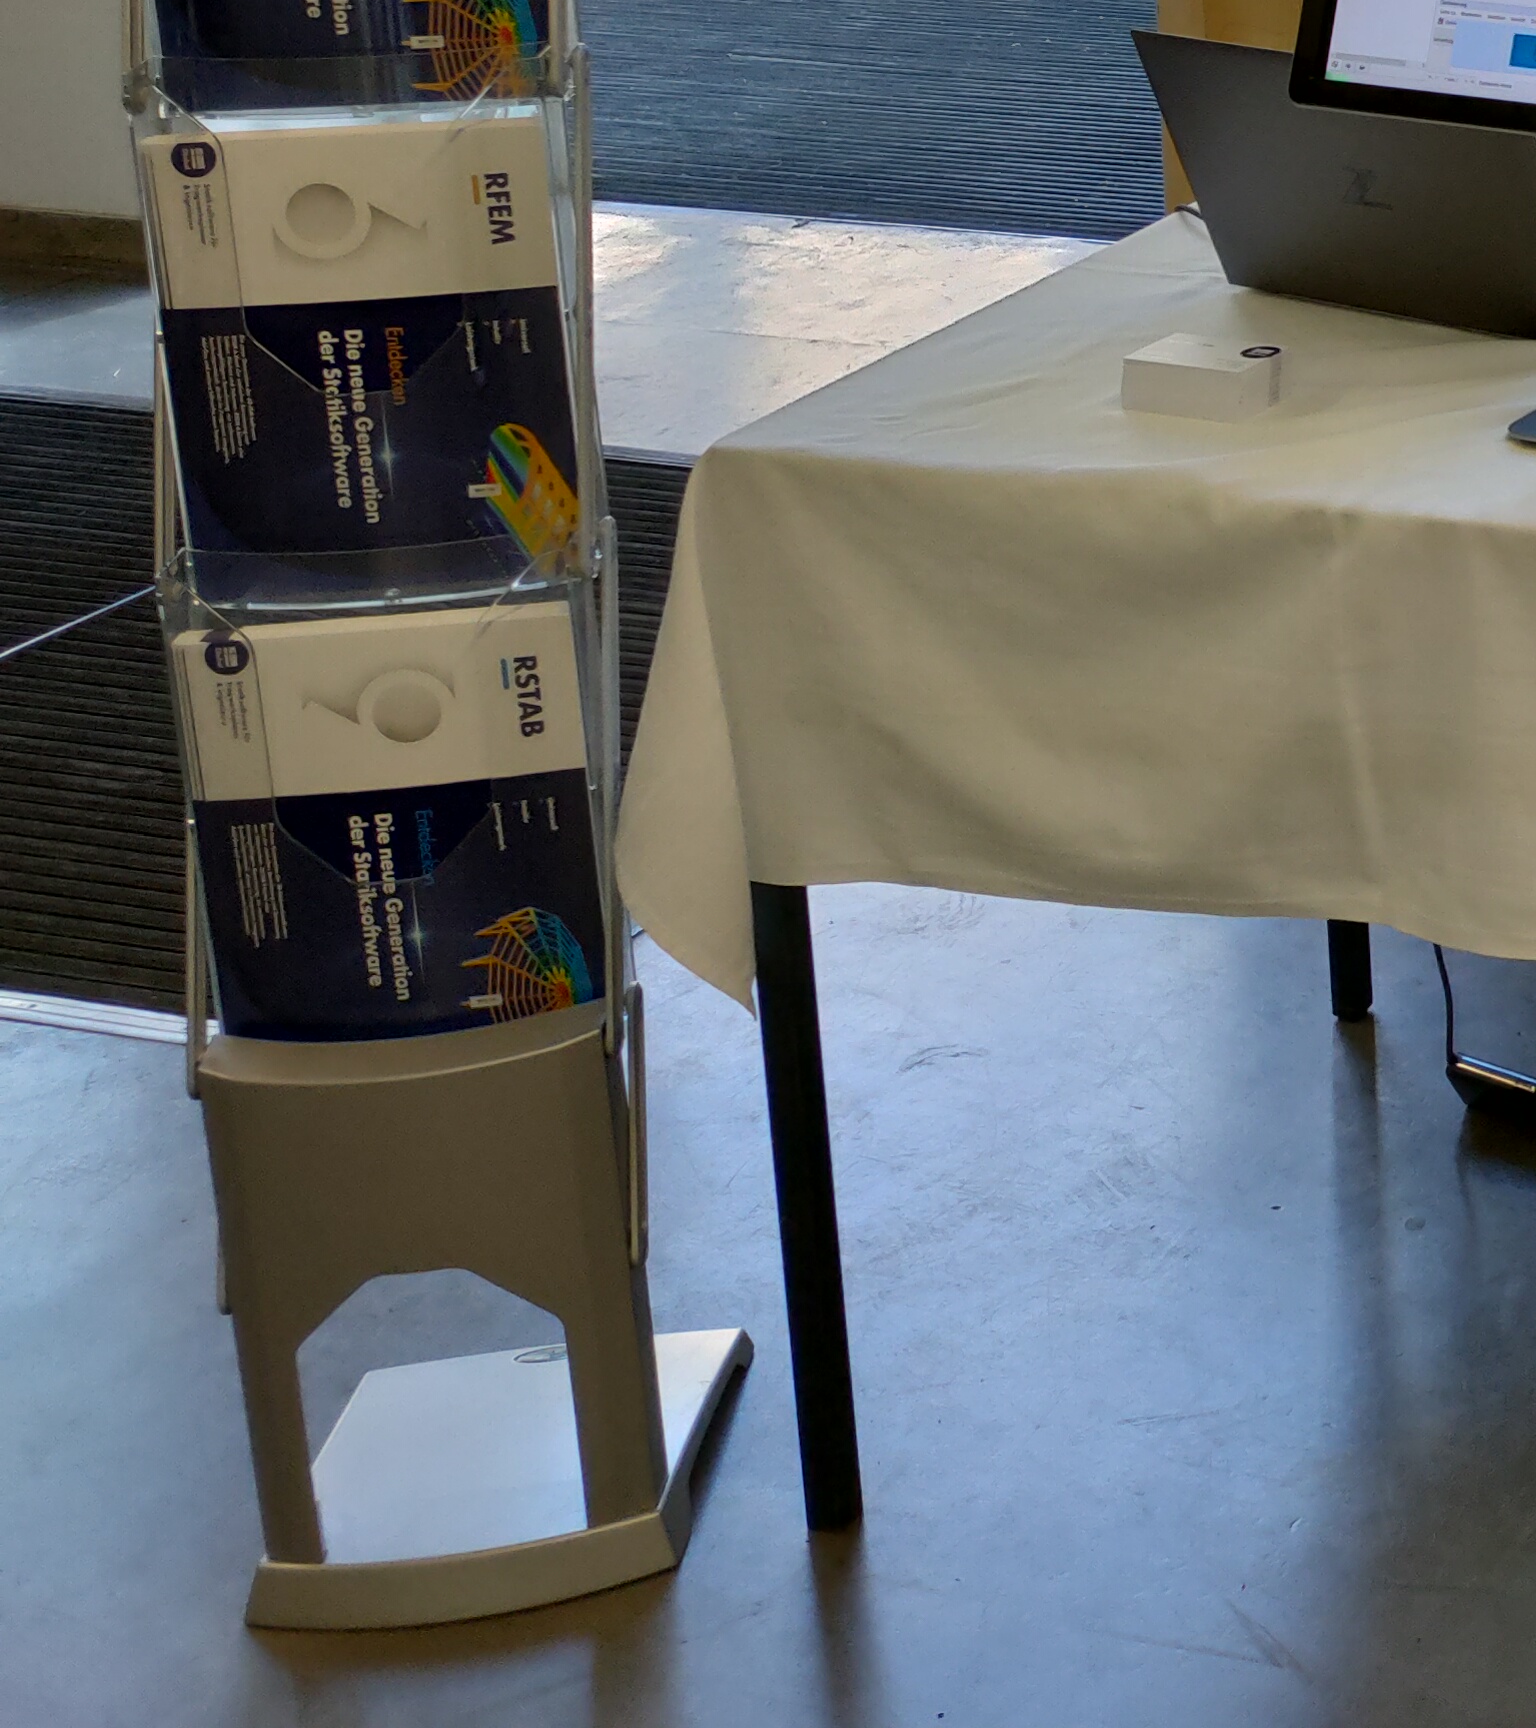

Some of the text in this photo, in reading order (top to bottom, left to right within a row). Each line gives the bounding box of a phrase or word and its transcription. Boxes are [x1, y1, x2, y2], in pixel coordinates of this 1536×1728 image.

[484, 173, 515, 244] RFEM
[385, 327, 407, 405] Entdecken
[317, 331, 354, 508] der Statiksoftware
[343, 329, 383, 524] Die neue Generation
[514, 656, 545, 737] RSTAB
[348, 815, 367, 846] der
[373, 813, 412, 1000] Die neue Generation
